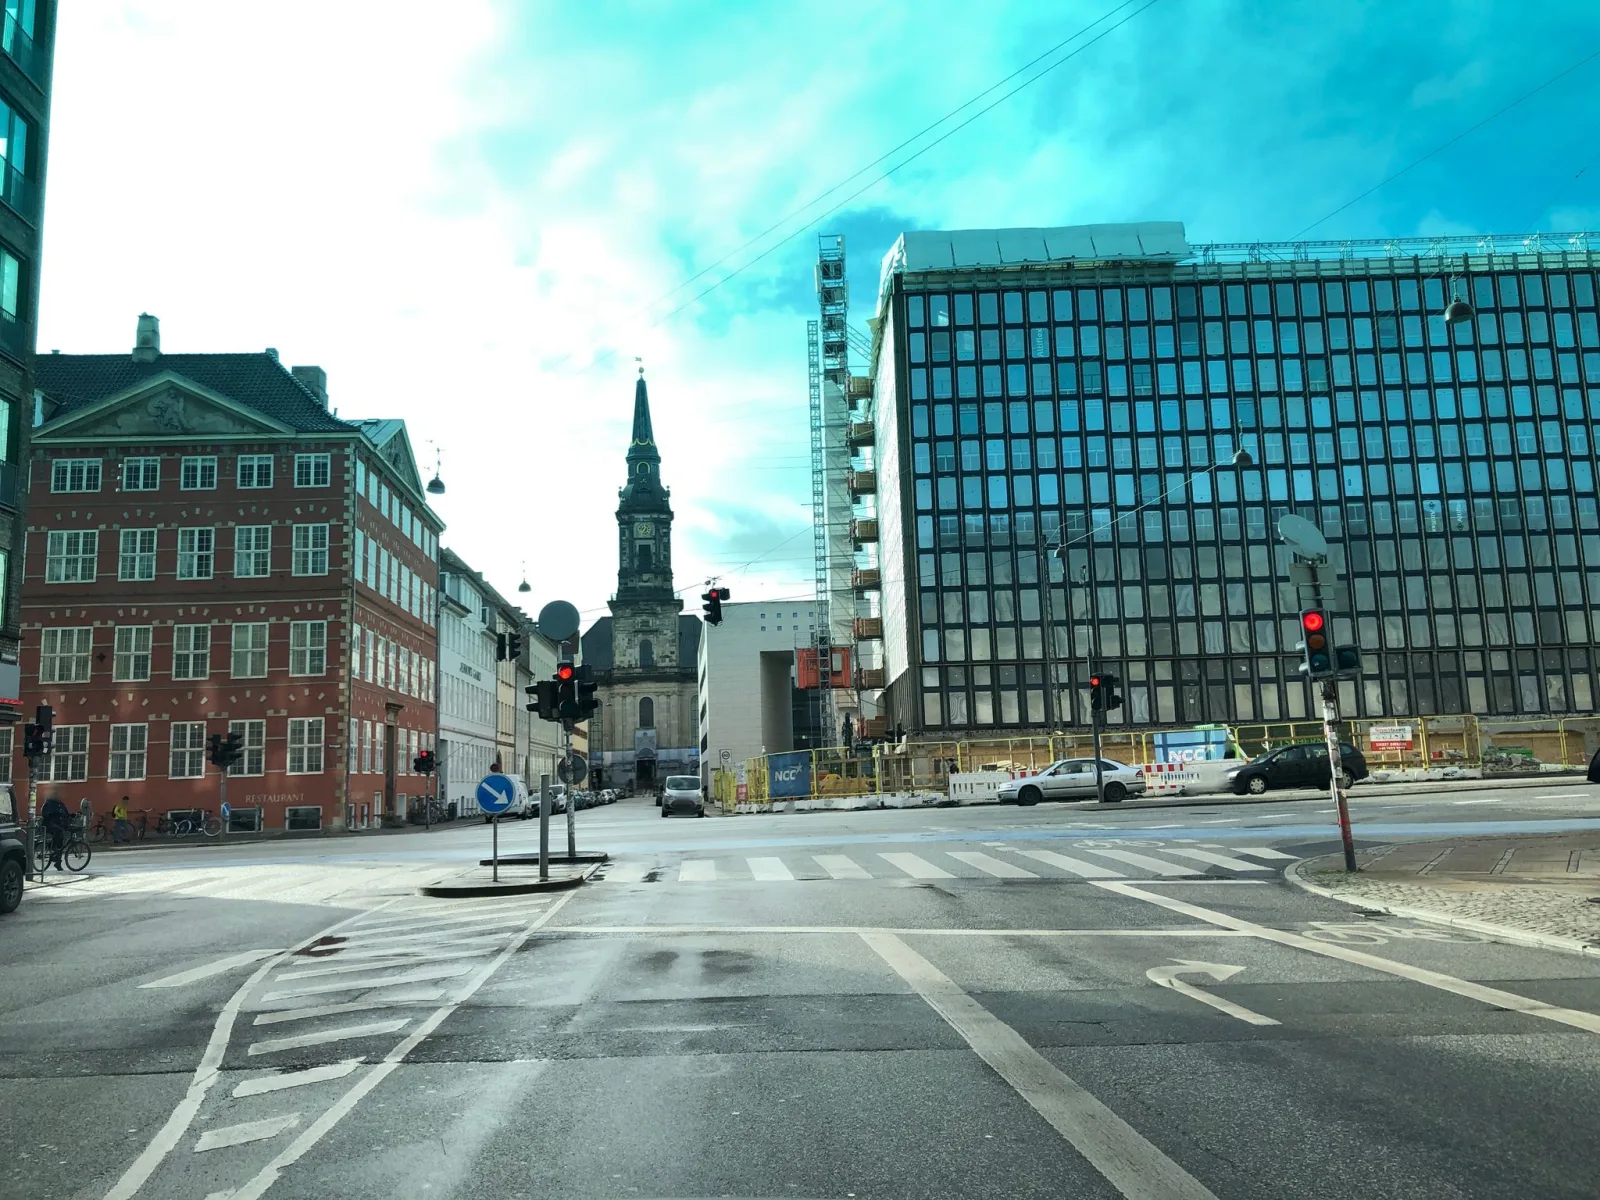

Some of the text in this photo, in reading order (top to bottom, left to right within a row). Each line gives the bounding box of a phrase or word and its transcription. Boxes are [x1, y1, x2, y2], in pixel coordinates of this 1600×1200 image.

[1168, 746, 1206, 762] NCC
[774, 769, 796, 781] NCC
[245, 793, 304, 803] RESTAURANT
